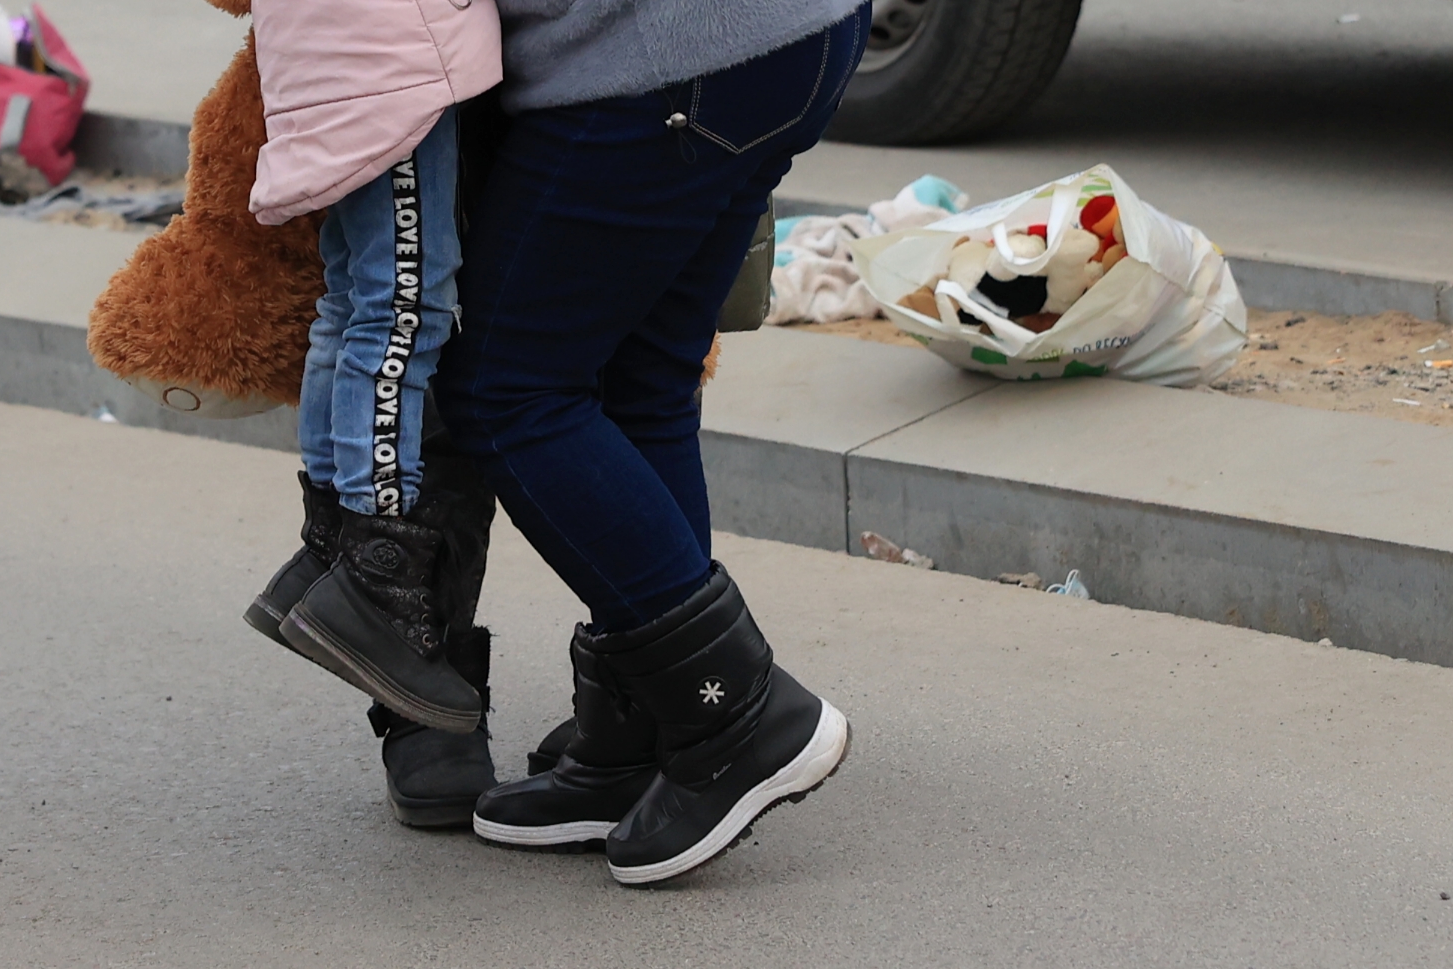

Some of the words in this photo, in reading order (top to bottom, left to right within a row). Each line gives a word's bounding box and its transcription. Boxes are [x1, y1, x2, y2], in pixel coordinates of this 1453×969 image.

[394, 196, 419, 255] LOVE
[375, 377, 399, 426] OVE
[374, 478, 400, 517] LOV
